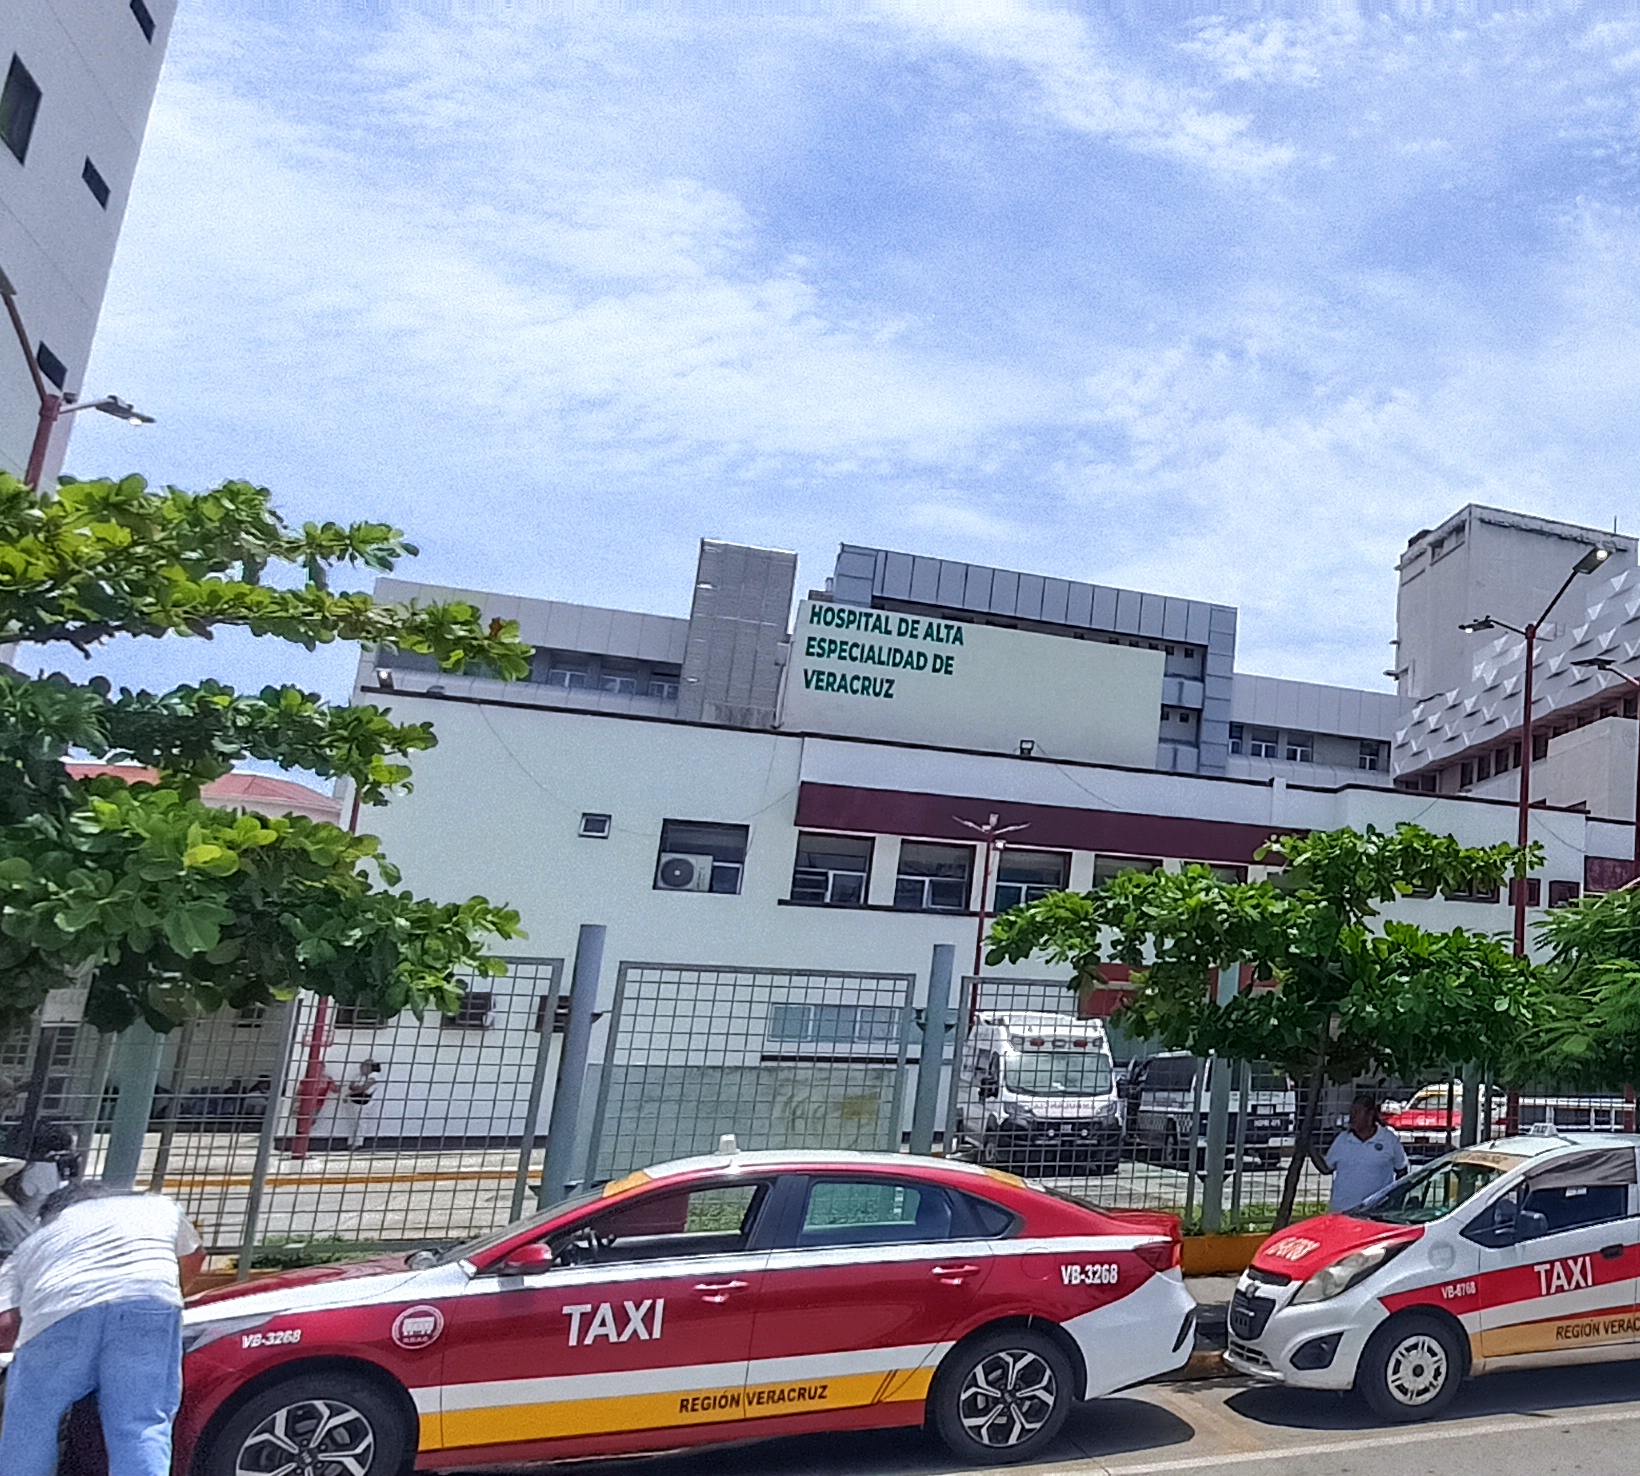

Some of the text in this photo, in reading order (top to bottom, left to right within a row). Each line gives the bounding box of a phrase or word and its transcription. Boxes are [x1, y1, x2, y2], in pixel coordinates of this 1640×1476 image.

[809, 604, 964, 645] HOSPITAL DE ALTA
[805, 637, 955, 675] ESPECIALIDAD DE
[803, 669, 896, 698] VERACRUZ
[1061, 1264, 1118, 1285] VB-3268
[1533, 1256, 1593, 1295] TAXI
[562, 1298, 665, 1346] TAXI
[1556, 1319, 1600, 1340] REGIÓN
[242, 1329, 301, 1348] VB-3268
[679, 1385, 828, 1413] REGIÓN VERACRUZ
